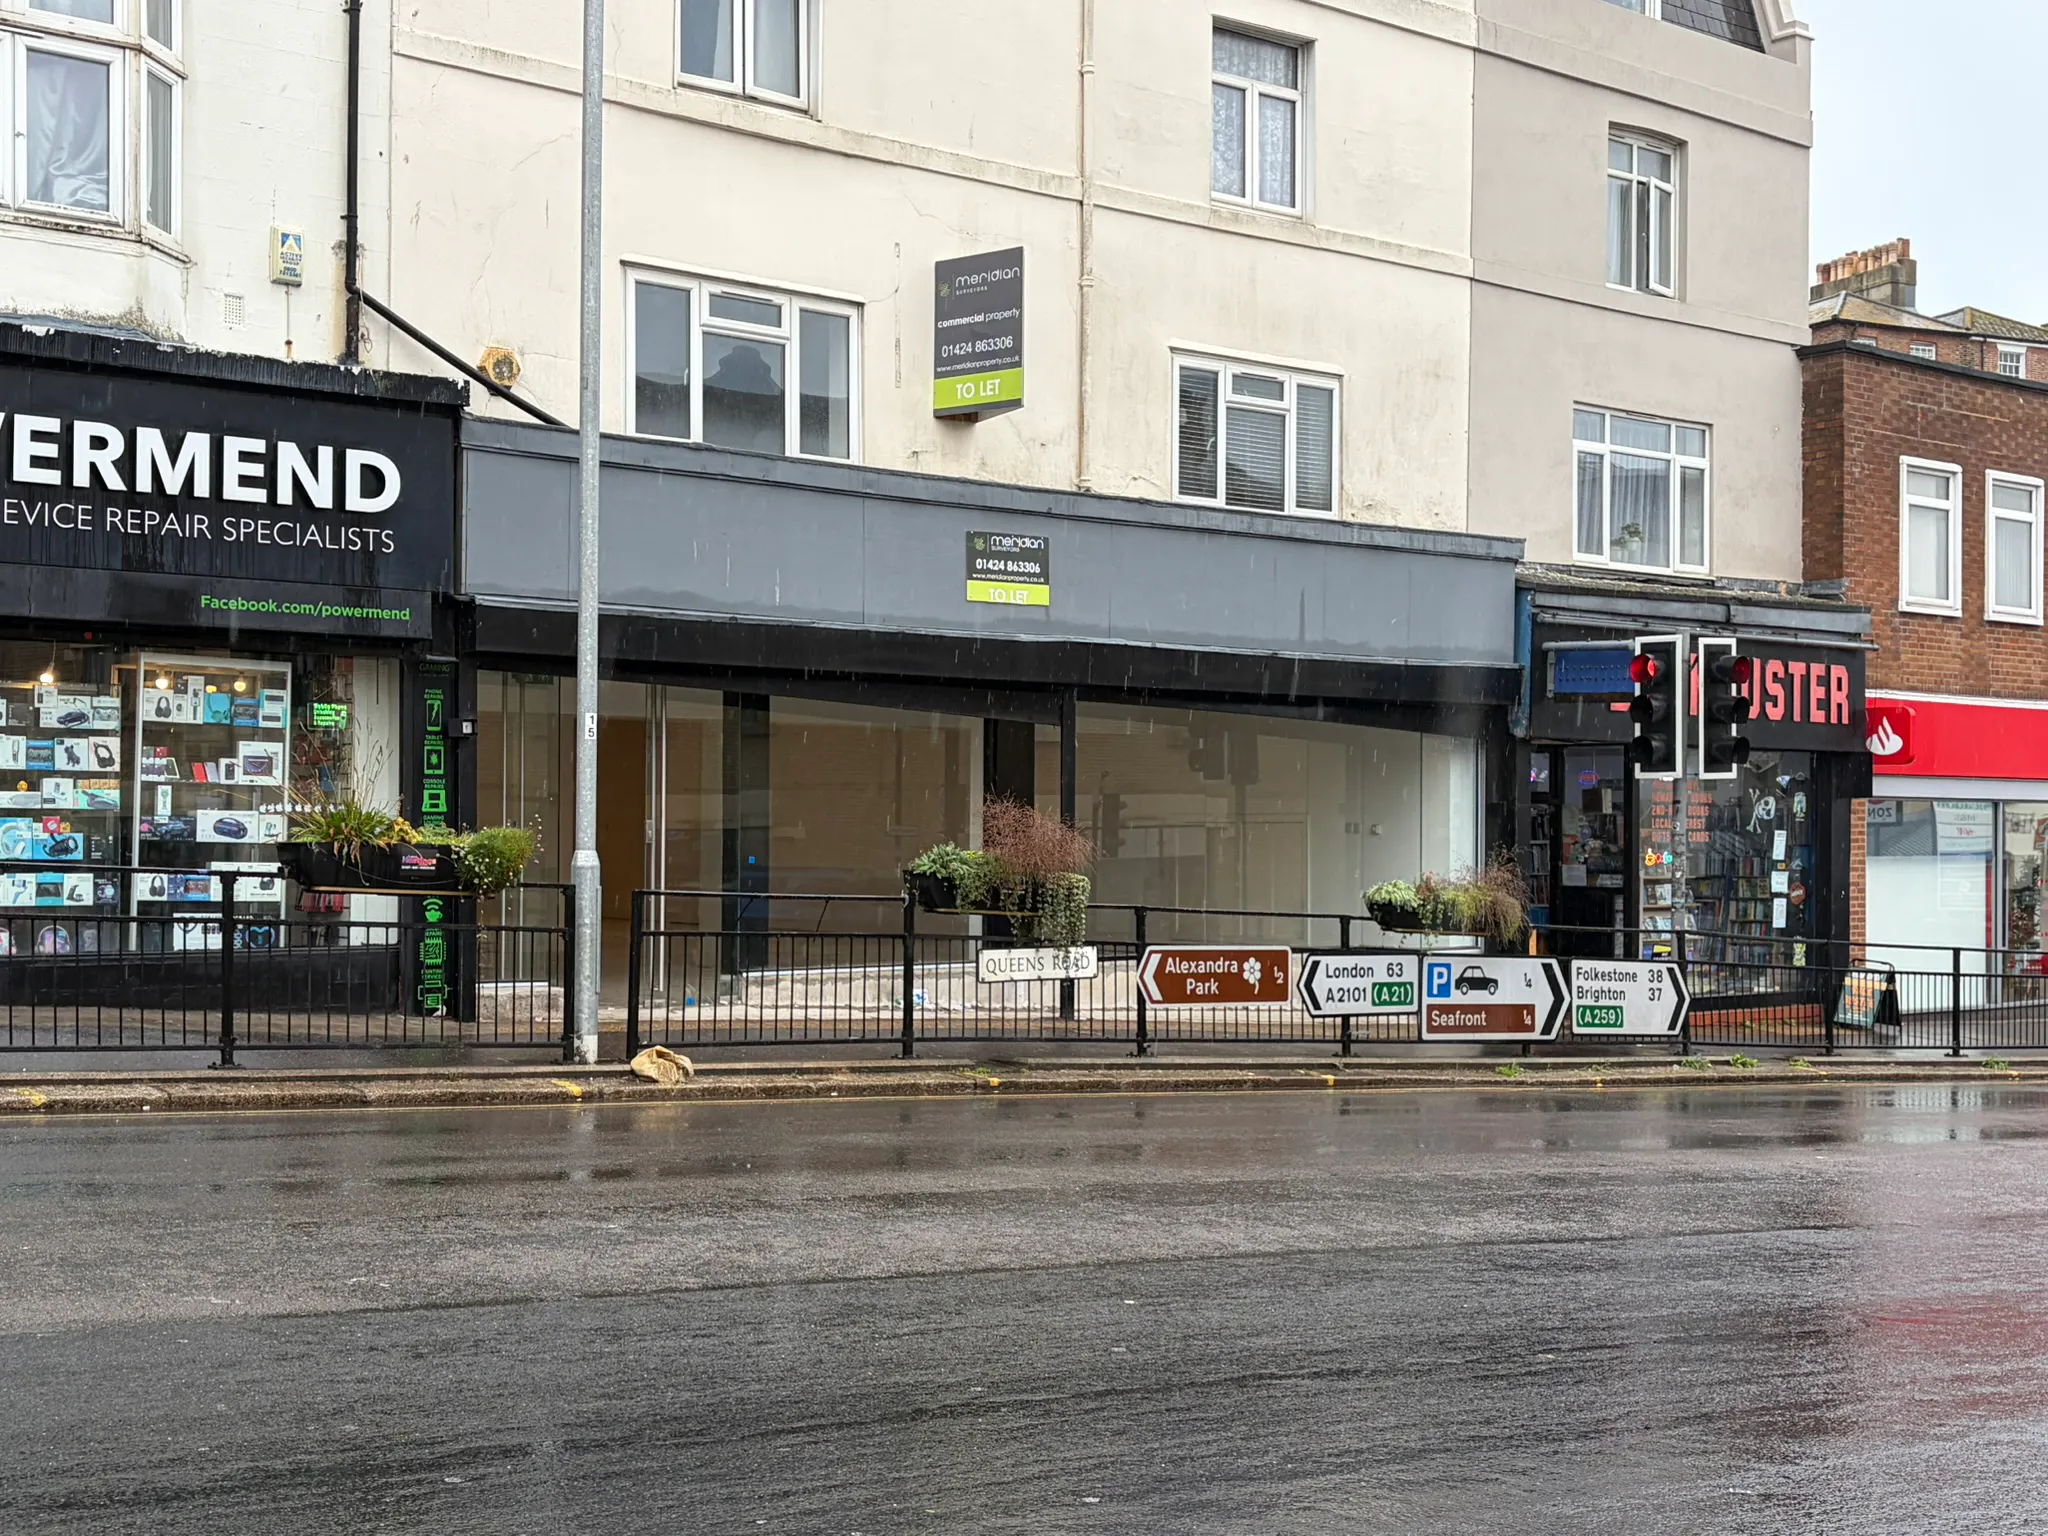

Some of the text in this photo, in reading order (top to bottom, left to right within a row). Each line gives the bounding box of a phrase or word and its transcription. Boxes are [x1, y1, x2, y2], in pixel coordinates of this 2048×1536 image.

[956, 267, 1020, 287] meridian
[937, 307, 1020, 328] commercial property
[942, 336, 1013, 358] 01424 863306
[956, 379, 1001, 400] TO LET
[106, 507, 212, 539] REPAIR
[223, 517, 395, 553] SPECIALISTS
[991, 534, 1044, 549] meridian
[976, 558, 1041, 573] 01424 863306
[989, 588, 1028, 605] TO LET
[201, 595, 411, 621] Facebook.com/powermend
[986, 954, 1091, 975] QUEENS ROAD
[1166, 955, 1238, 974] Alexandra
[1325, 962, 1404, 979] London 63
[1432, 968, 1449, 994] P
[1576, 967, 1664, 983] Folkestone 38
[1186, 978, 1219, 995] Park
[1373, 984, 1413, 1005] (A21)
[1576, 986, 1663, 1002] Brighton 37
[1431, 1010, 1487, 1027] Seafront
[1577, 1007, 1623, 1027] (A259)
